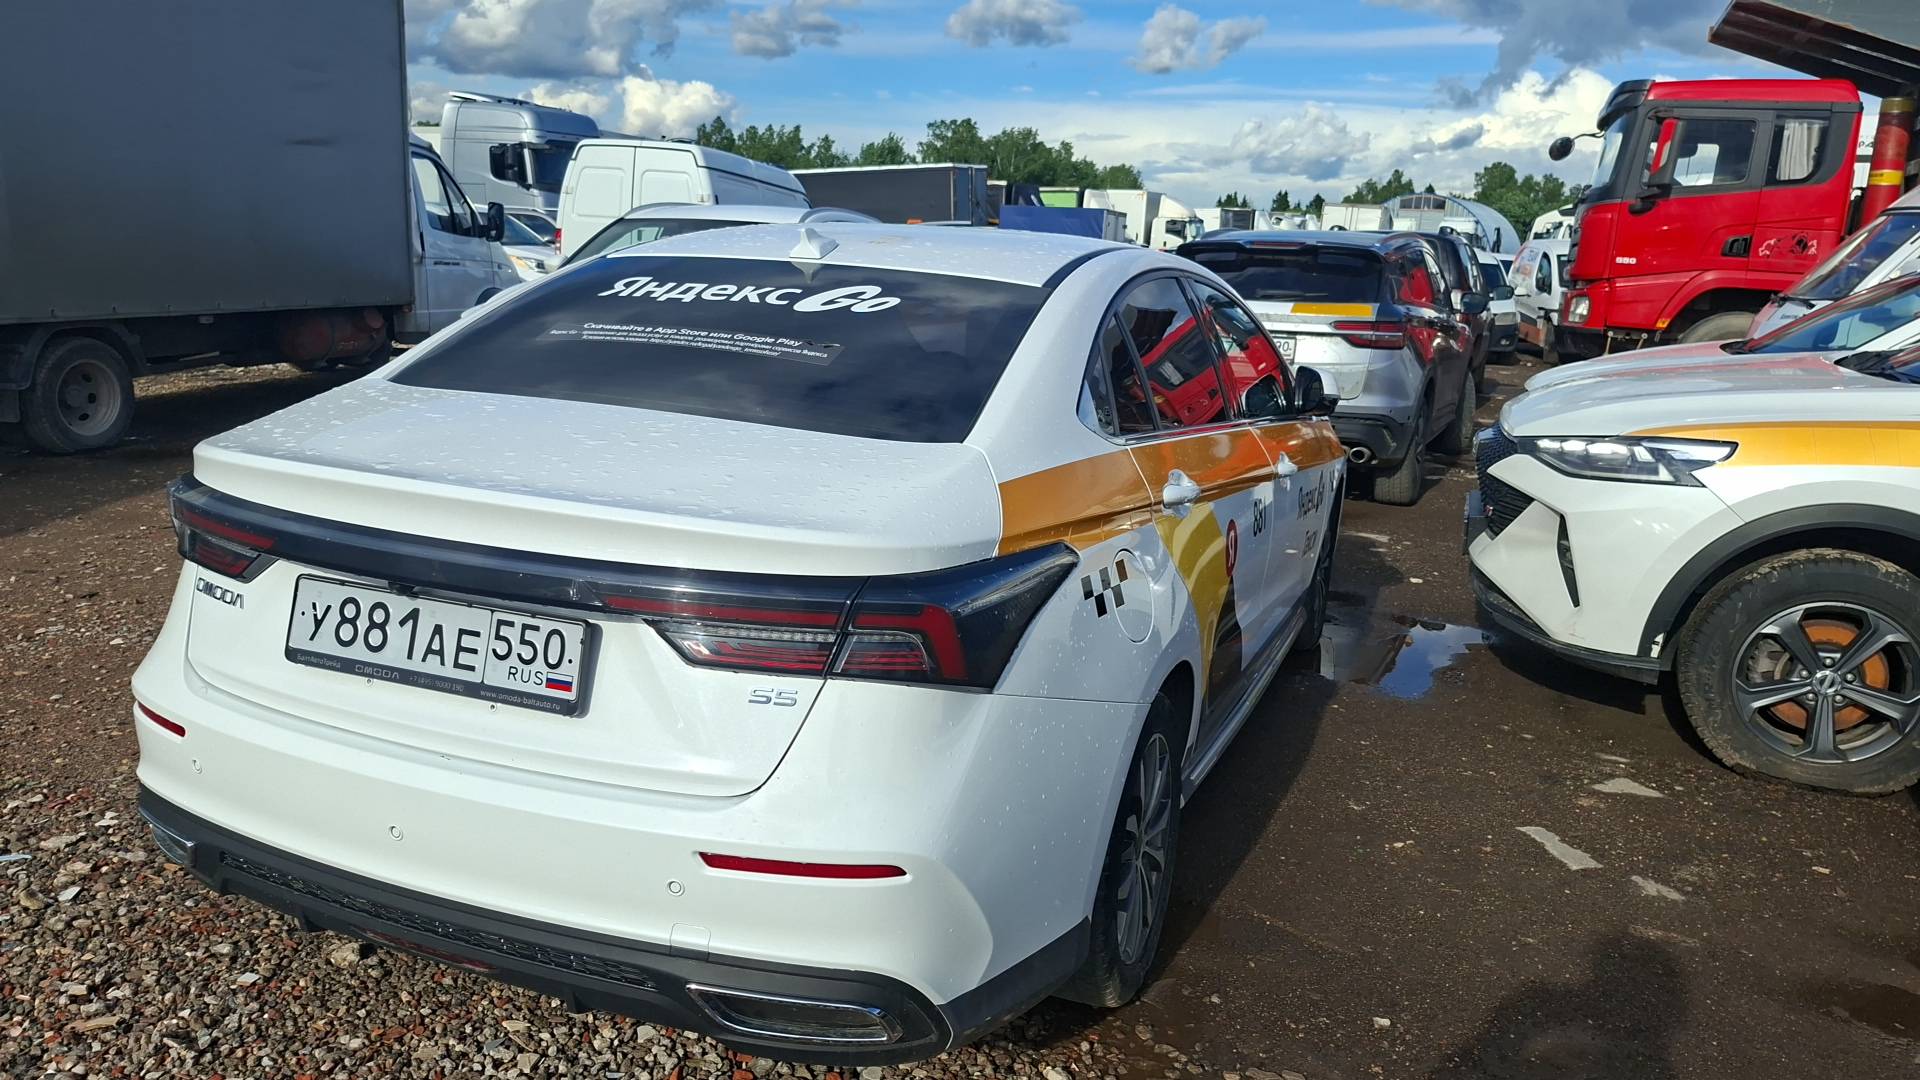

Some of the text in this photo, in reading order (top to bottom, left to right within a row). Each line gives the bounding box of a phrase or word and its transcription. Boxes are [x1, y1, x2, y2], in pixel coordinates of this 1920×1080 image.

[598, 277, 900, 312] Яндекс Go
[584, 323, 644, 332] Скачивайте
[678, 328, 708, 336] Store
[734, 333, 775, 342] Google
[776, 338, 802, 346] Play
[1253, 496, 1267, 537] 881
[196, 577, 245, 609] OMODA
[308, 596, 565, 672] У881АЕ 550
[355, 664, 400, 680] OMODA
[508, 666, 544, 686] RUS
[748, 688, 798, 707] S5
